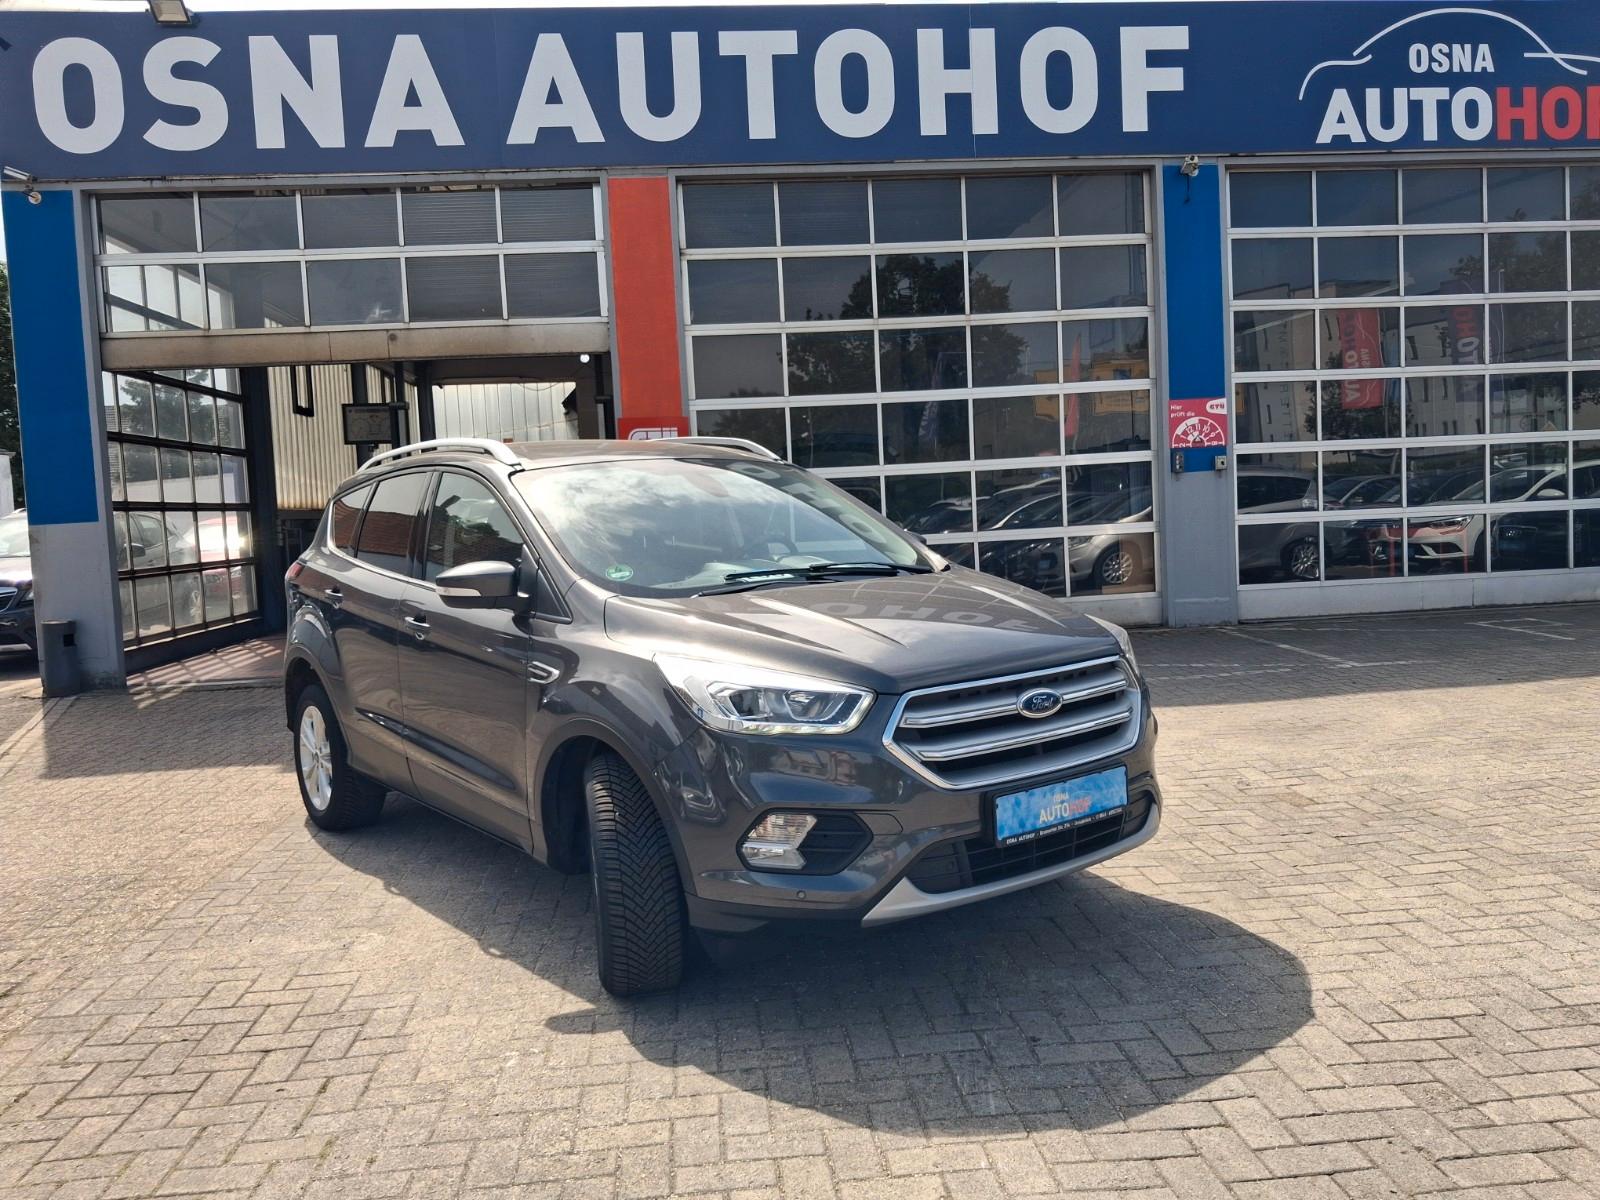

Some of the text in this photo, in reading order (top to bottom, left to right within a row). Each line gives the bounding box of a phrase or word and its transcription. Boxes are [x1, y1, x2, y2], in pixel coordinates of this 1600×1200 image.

[1408, 42, 1495, 73] OSNA
[32, 25, 1190, 154] OSNA AUTOHOF
[1031, 695, 1053, 710] Ford
